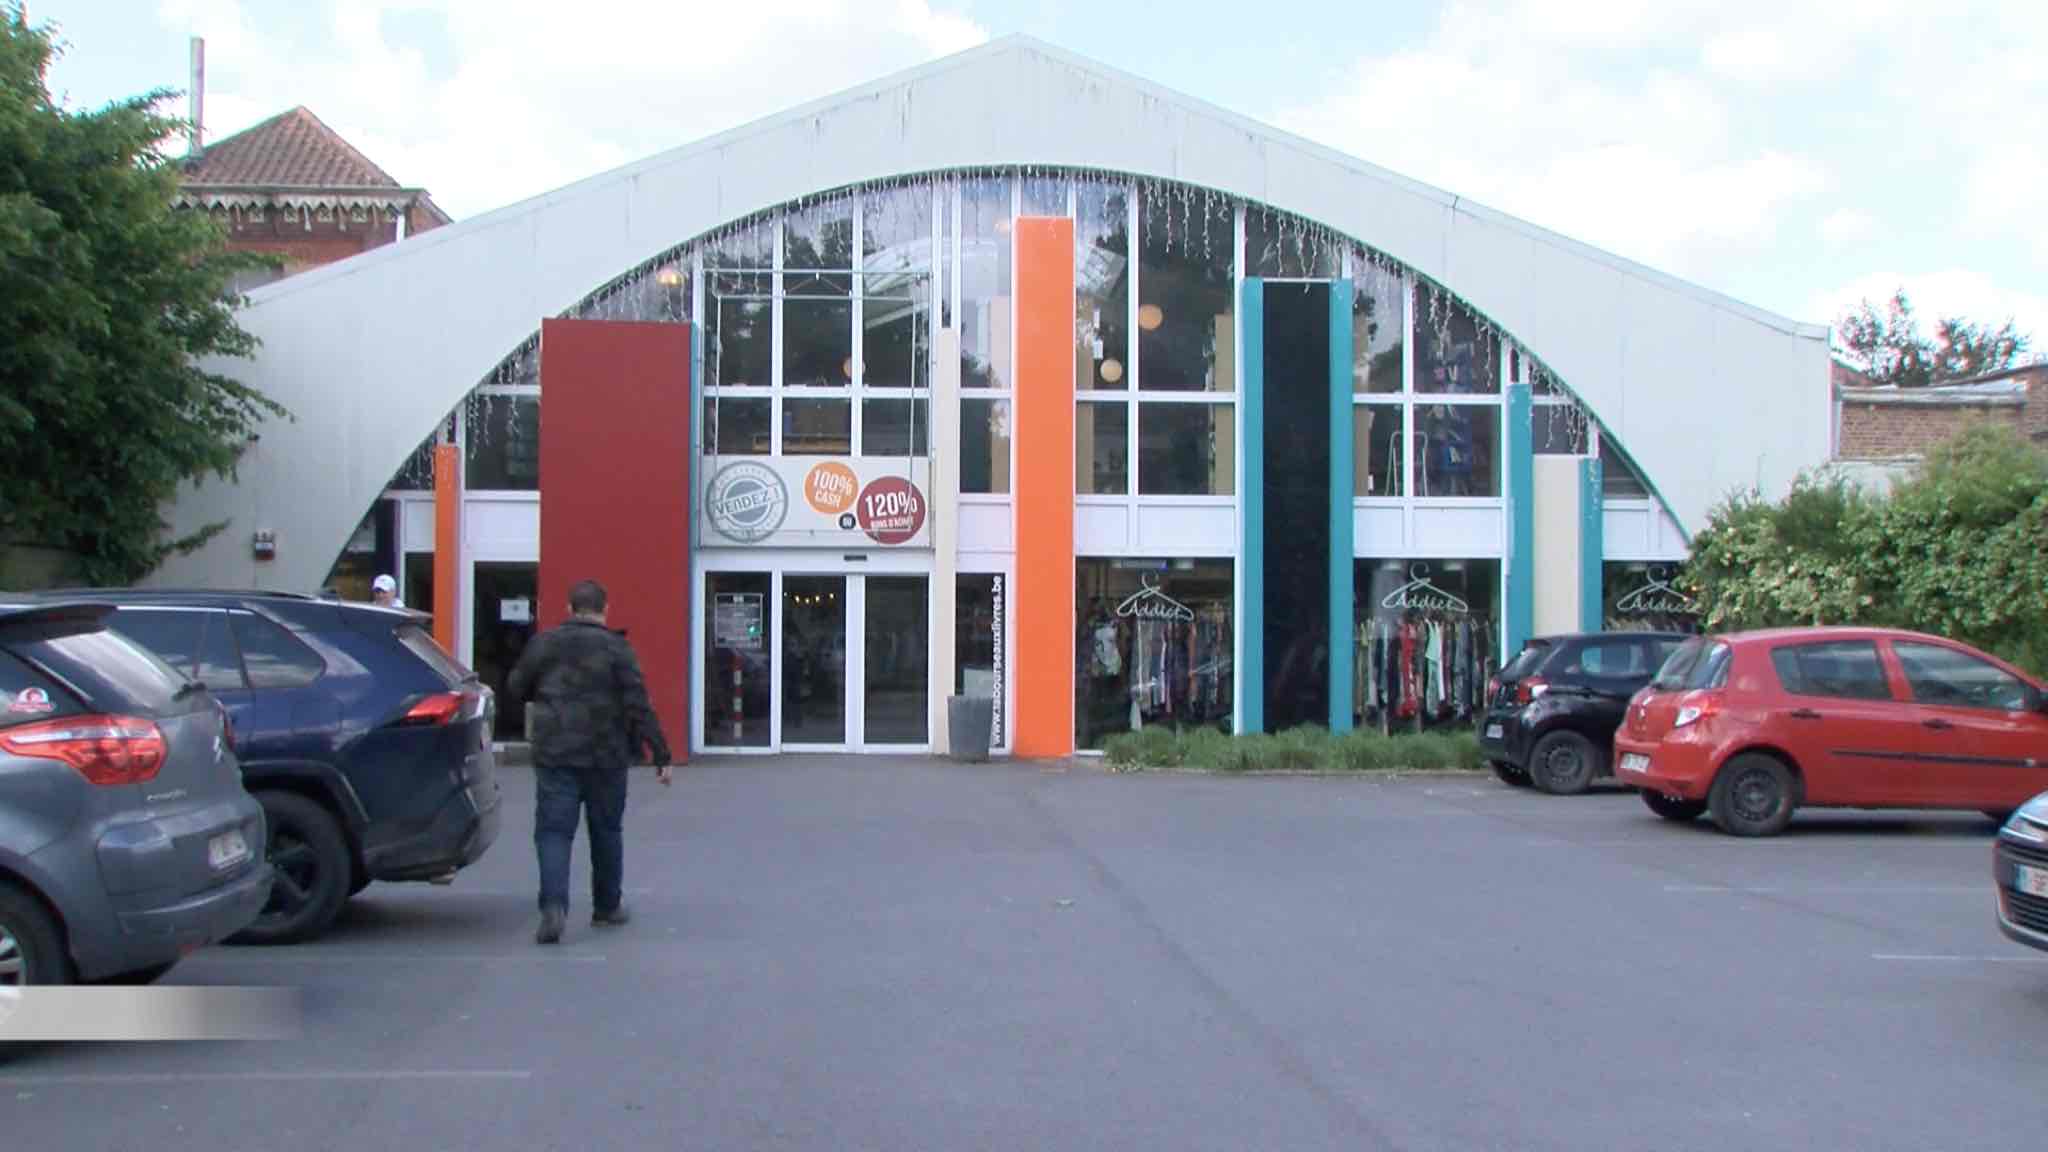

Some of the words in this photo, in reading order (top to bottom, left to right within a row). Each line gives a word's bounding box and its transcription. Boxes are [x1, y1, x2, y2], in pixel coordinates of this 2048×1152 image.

[814, 469, 853, 496] 100%
[815, 490, 841, 509] CASH
[865, 491, 918, 518] 120%
